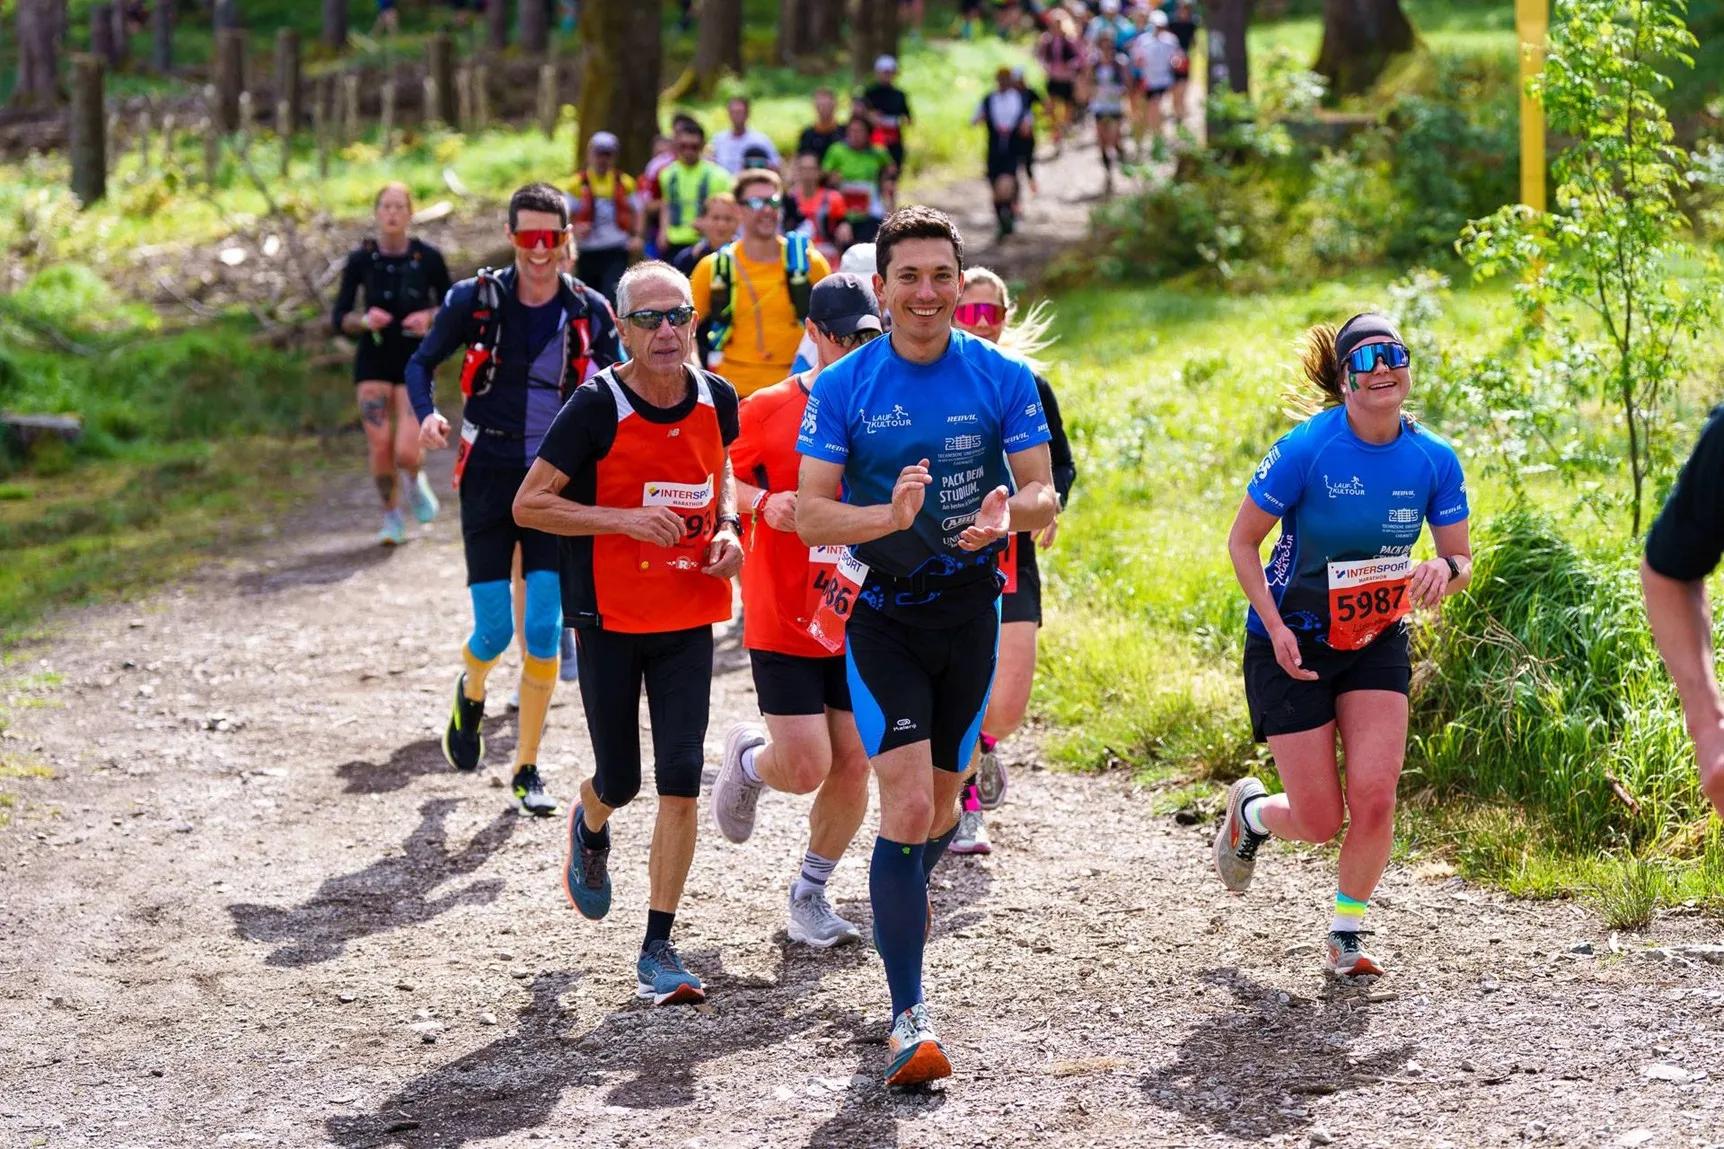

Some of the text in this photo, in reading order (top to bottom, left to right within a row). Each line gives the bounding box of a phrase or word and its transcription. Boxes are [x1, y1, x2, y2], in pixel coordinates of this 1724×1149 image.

[871, 419, 912, 428] KULTOUR
[942, 471, 965, 488] PACK
[940, 481, 980, 504] STUDIUM.
[1346, 560, 1409, 579] INTERSPORT
[1337, 584, 1407, 623] 5987
